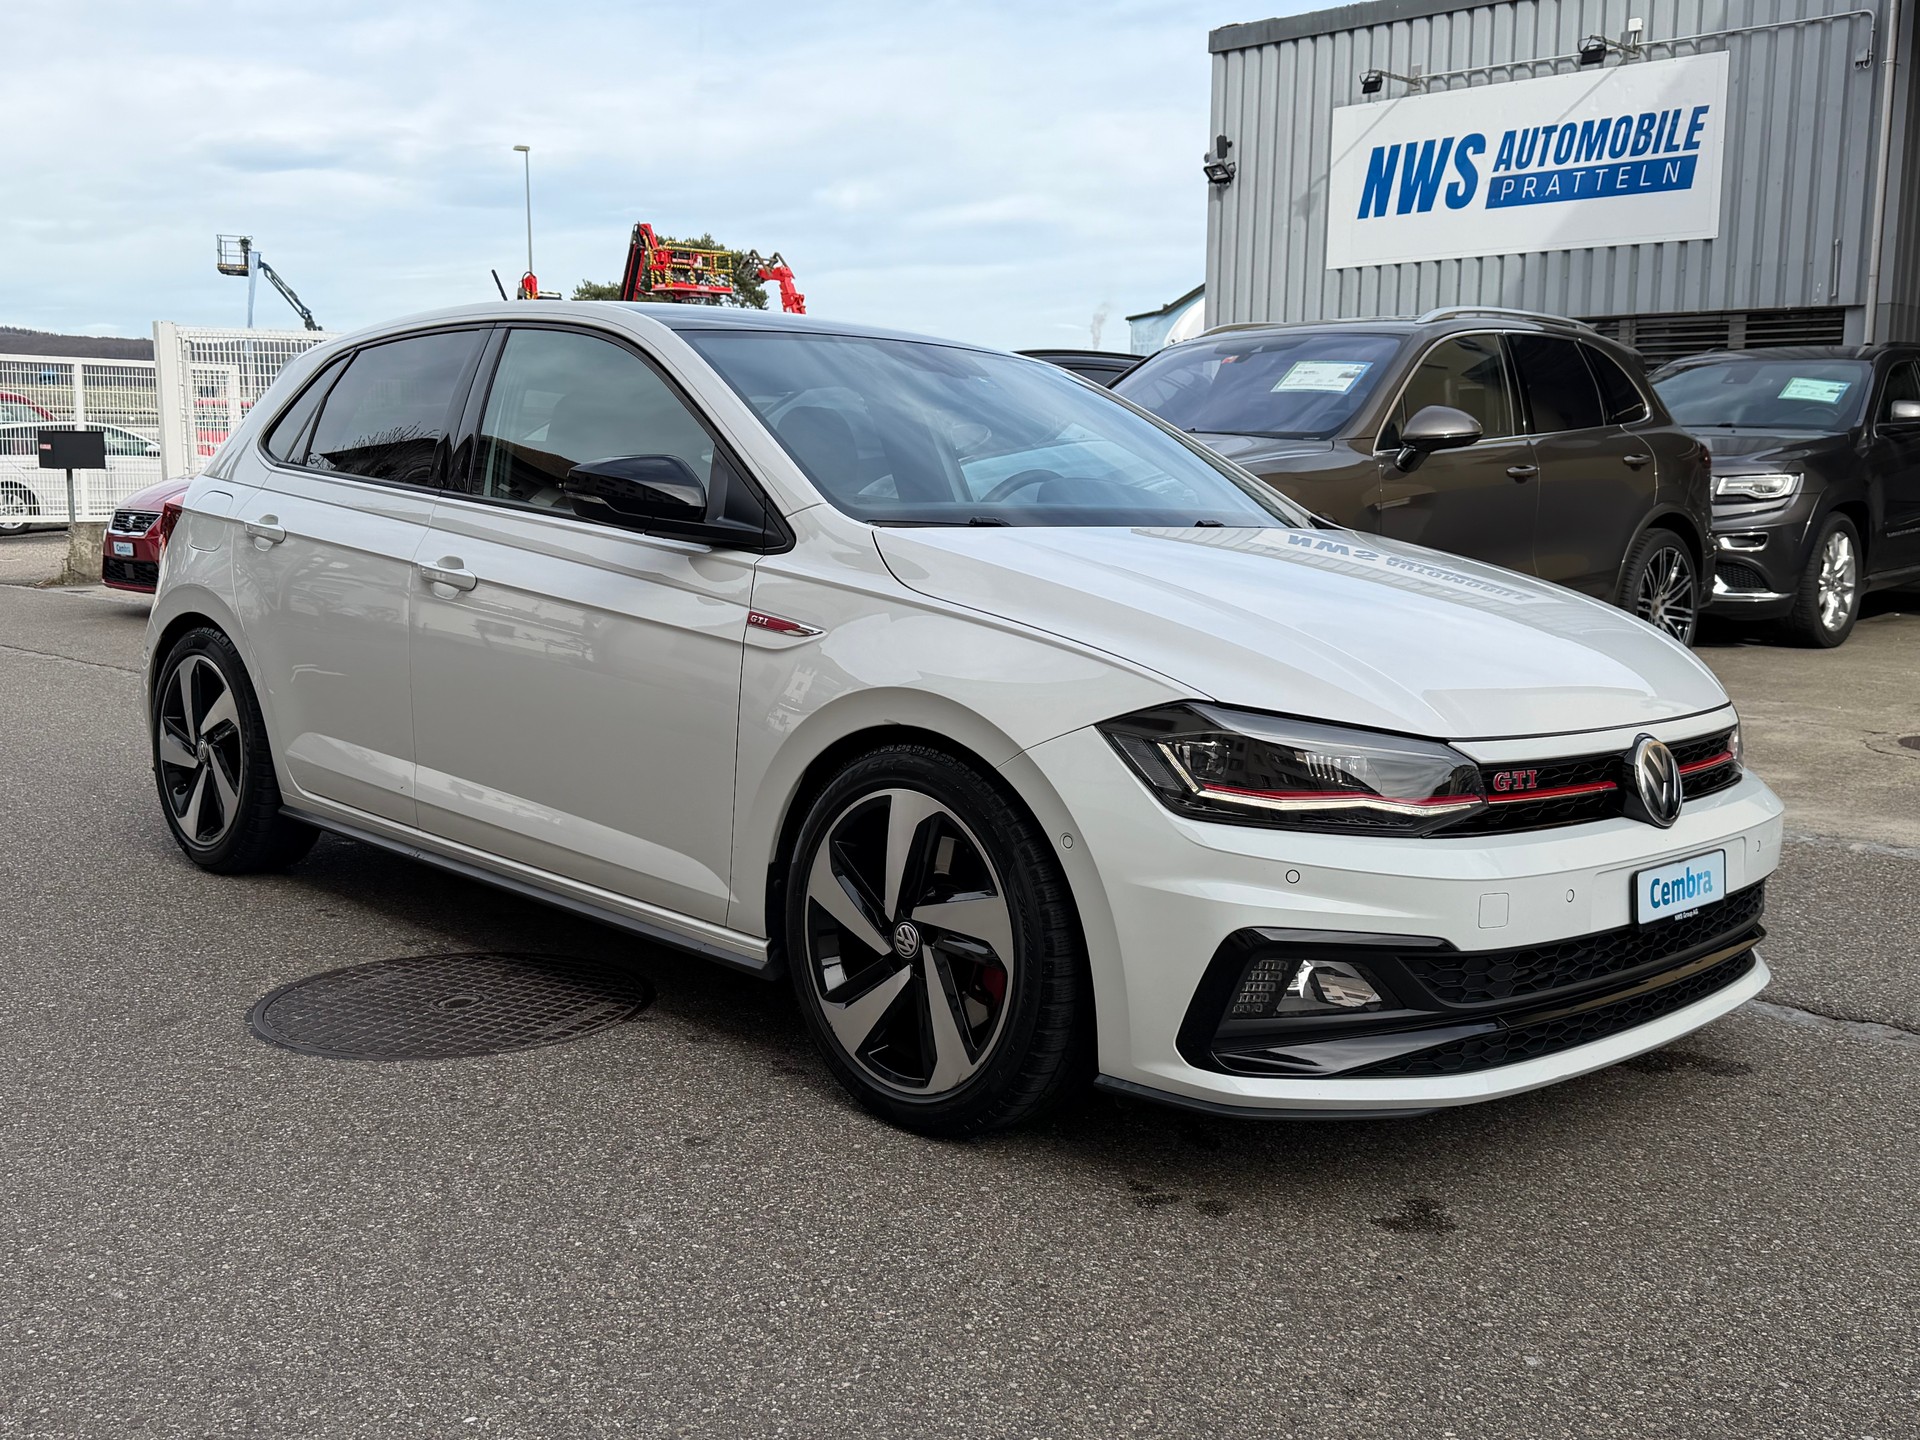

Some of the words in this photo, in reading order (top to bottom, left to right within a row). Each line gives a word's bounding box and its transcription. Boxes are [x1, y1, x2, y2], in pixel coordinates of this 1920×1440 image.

[1494, 105, 1710, 172] AUTOMOBILE
[1357, 133, 1486, 219] NWS
[1501, 161, 1682, 200] PRATTELN
[750, 615, 768, 625] GTI
[1493, 769, 1537, 791] GTI
[1650, 867, 1713, 909] Cembra
